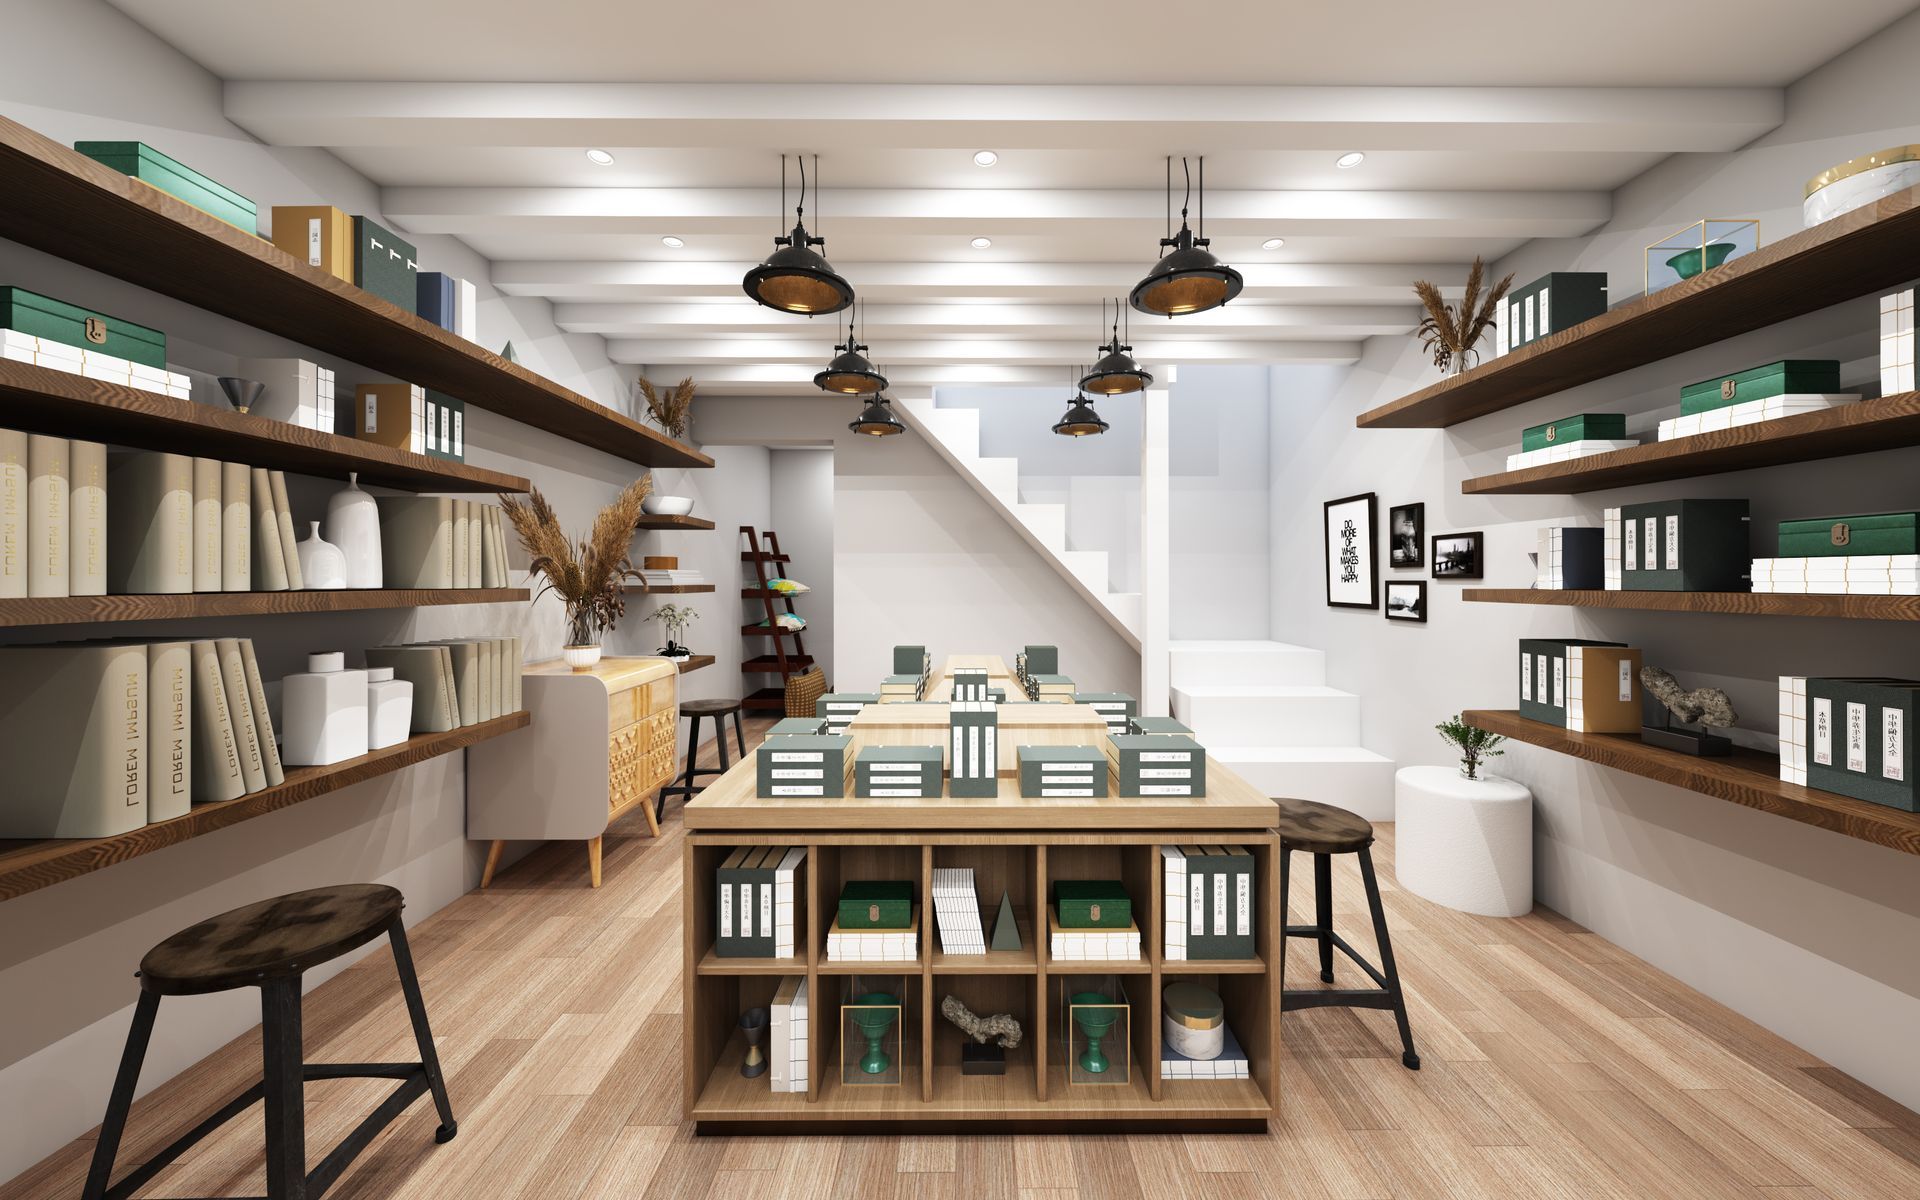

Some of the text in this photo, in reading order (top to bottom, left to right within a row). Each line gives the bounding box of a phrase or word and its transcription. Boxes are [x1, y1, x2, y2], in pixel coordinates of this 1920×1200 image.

[1344, 519, 1353, 529] DO
[1341, 528, 1356, 538] MORE
[1345, 537, 1352, 547] OF
[1342, 546, 1356, 556] WHAT
[1340, 555, 1359, 565] MAKES
[1344, 565, 1355, 574] YOU
